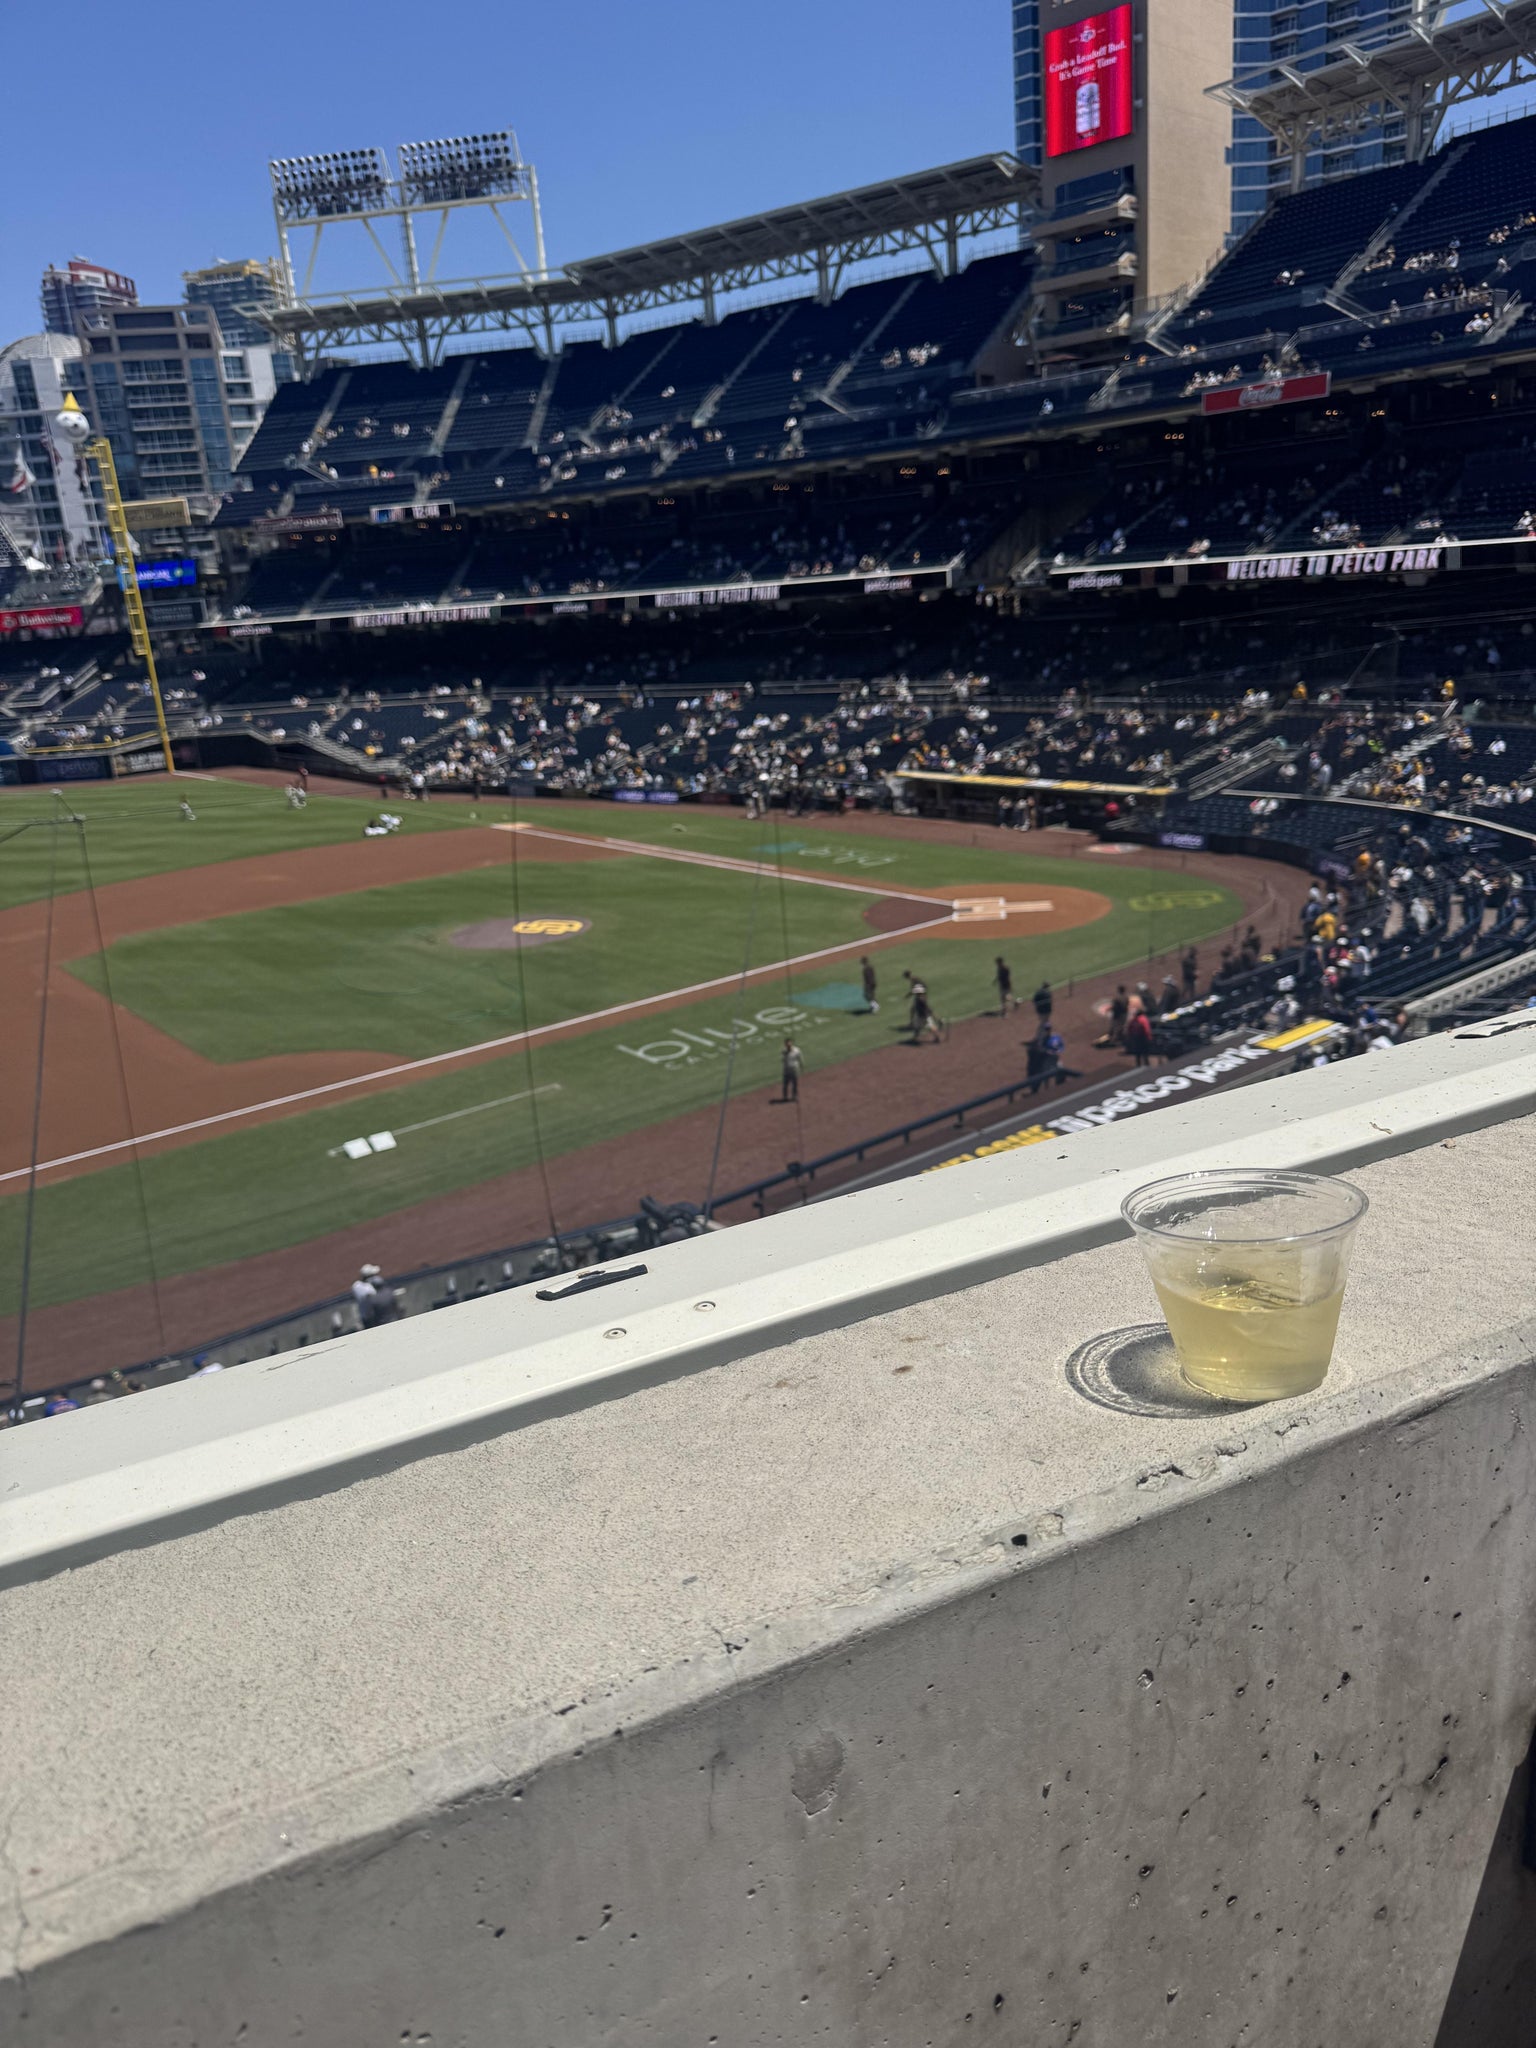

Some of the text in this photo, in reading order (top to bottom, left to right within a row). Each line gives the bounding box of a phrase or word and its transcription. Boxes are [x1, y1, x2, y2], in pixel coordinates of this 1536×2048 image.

[1072, 62, 1095, 77] Game
[1096, 56, 1117, 69] Time
[1226, 547, 1442, 580] WELCOME TO PETCO PARK
[615, 1006, 808, 1064] blue
[1076, 1075, 1192, 1125] petco
[1177, 1042, 1271, 1084] park
